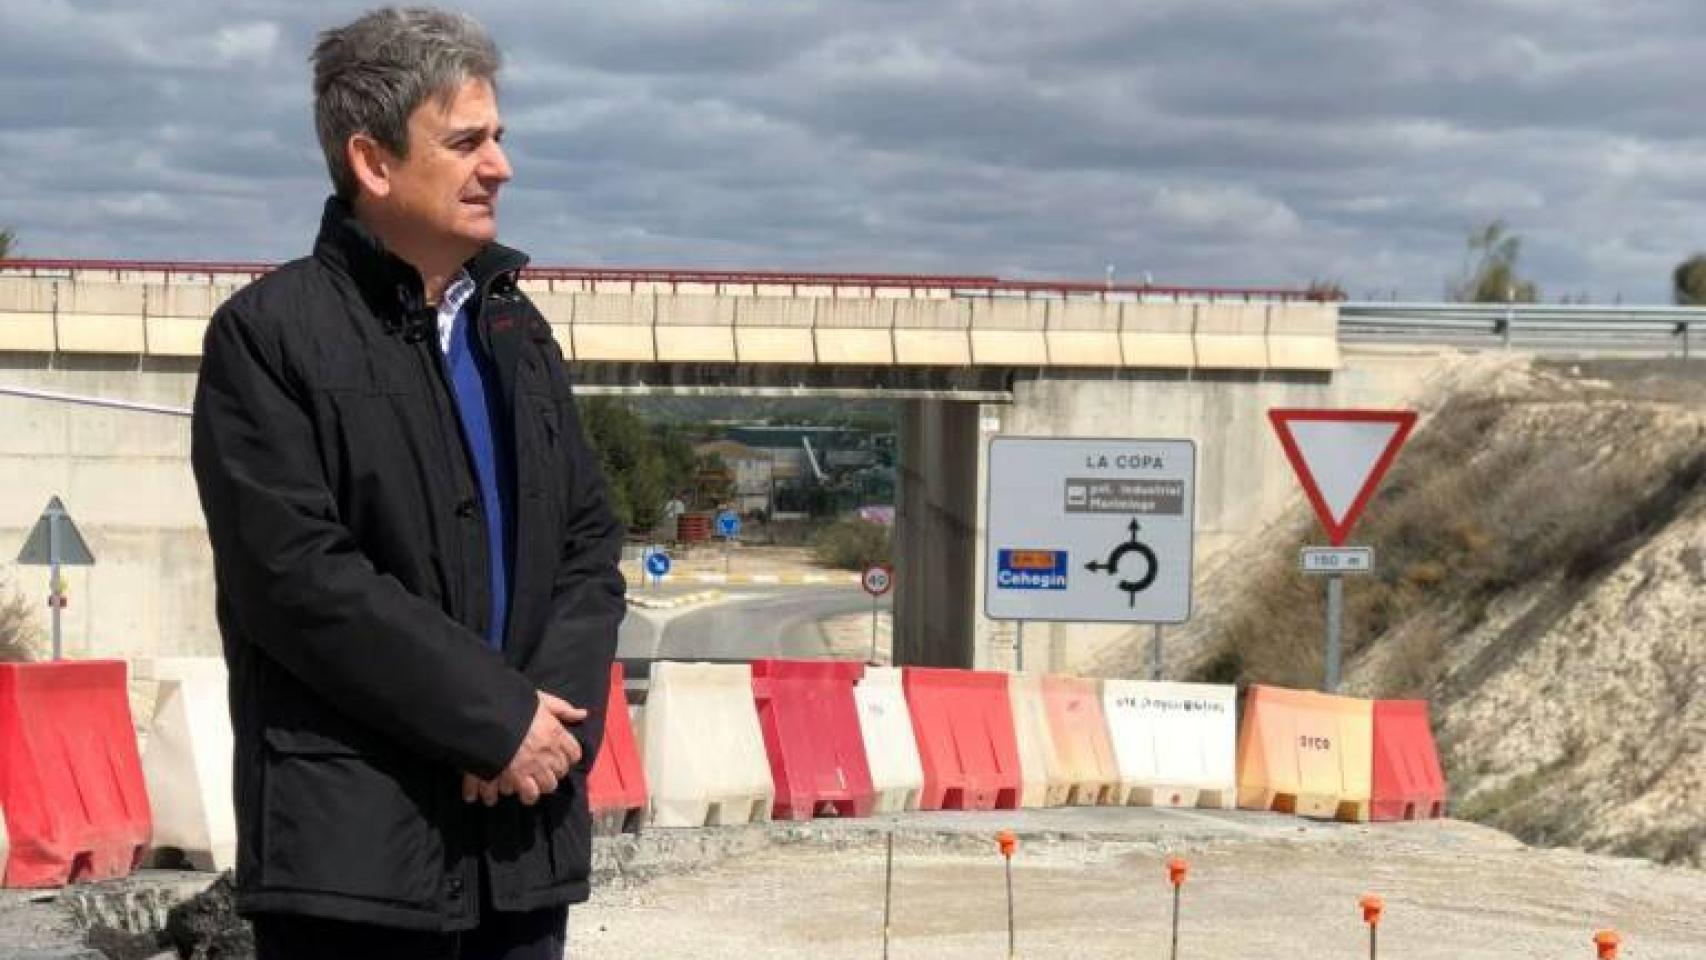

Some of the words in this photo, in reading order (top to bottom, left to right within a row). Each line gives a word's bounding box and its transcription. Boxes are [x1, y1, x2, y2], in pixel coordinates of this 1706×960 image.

[1086, 455, 1108, 469] LA
[1116, 455, 1163, 469] COPA
[868, 575, 887, 586] 40
